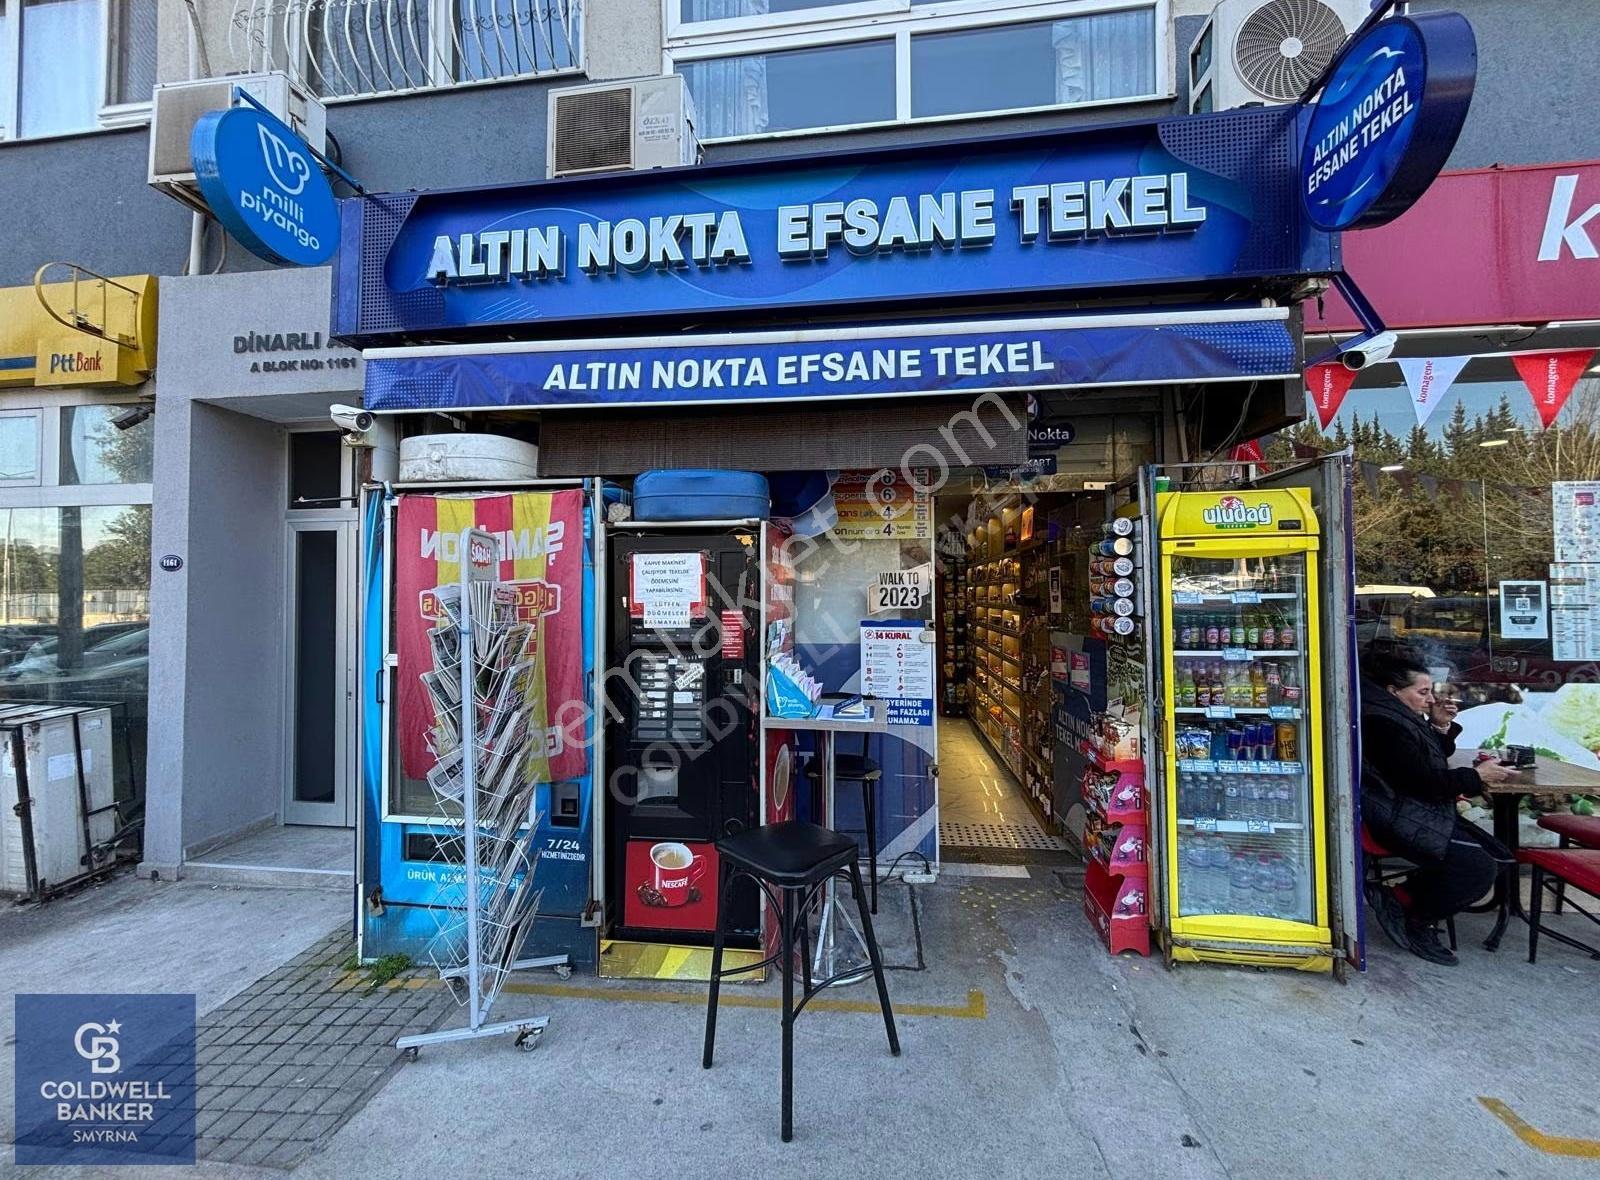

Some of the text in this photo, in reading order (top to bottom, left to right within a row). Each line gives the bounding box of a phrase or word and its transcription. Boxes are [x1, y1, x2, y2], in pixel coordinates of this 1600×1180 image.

[1313, 66, 1406, 166] ALTIN NOKTA
[1307, 90, 1414, 195] EFSANE TEKEL
[263, 185, 304, 224] milli
[240, 189, 320, 250] piyango
[424, 172, 1207, 280] ALTIN NOKTA EFSANE TEKEL
[233, 330, 320, 354] DİNARLI
[250, 361, 261, 373] A
[262, 359, 298, 373] BLOK
[326, 357, 357, 369] 1161
[542, 340, 1055, 390] ALTIN NOKTA EFSANE TEKEL
[1320, 368, 1333, 409] komagene
[1416, 360, 1434, 404] komagene
[1544, 357, 1560, 405] komagene
[1028, 428, 1070, 440] Nokta
[1203, 502, 1273, 526] uludağ
[879, 572, 920, 585] WALK TO
[879, 586, 920, 608] 2023
[885, 632, 912, 640] KURAL
[899, 708, 930, 717] FAZLASI
[547, 838, 580, 850] 7/24
[407, 868, 436, 882] ÜRÜN
